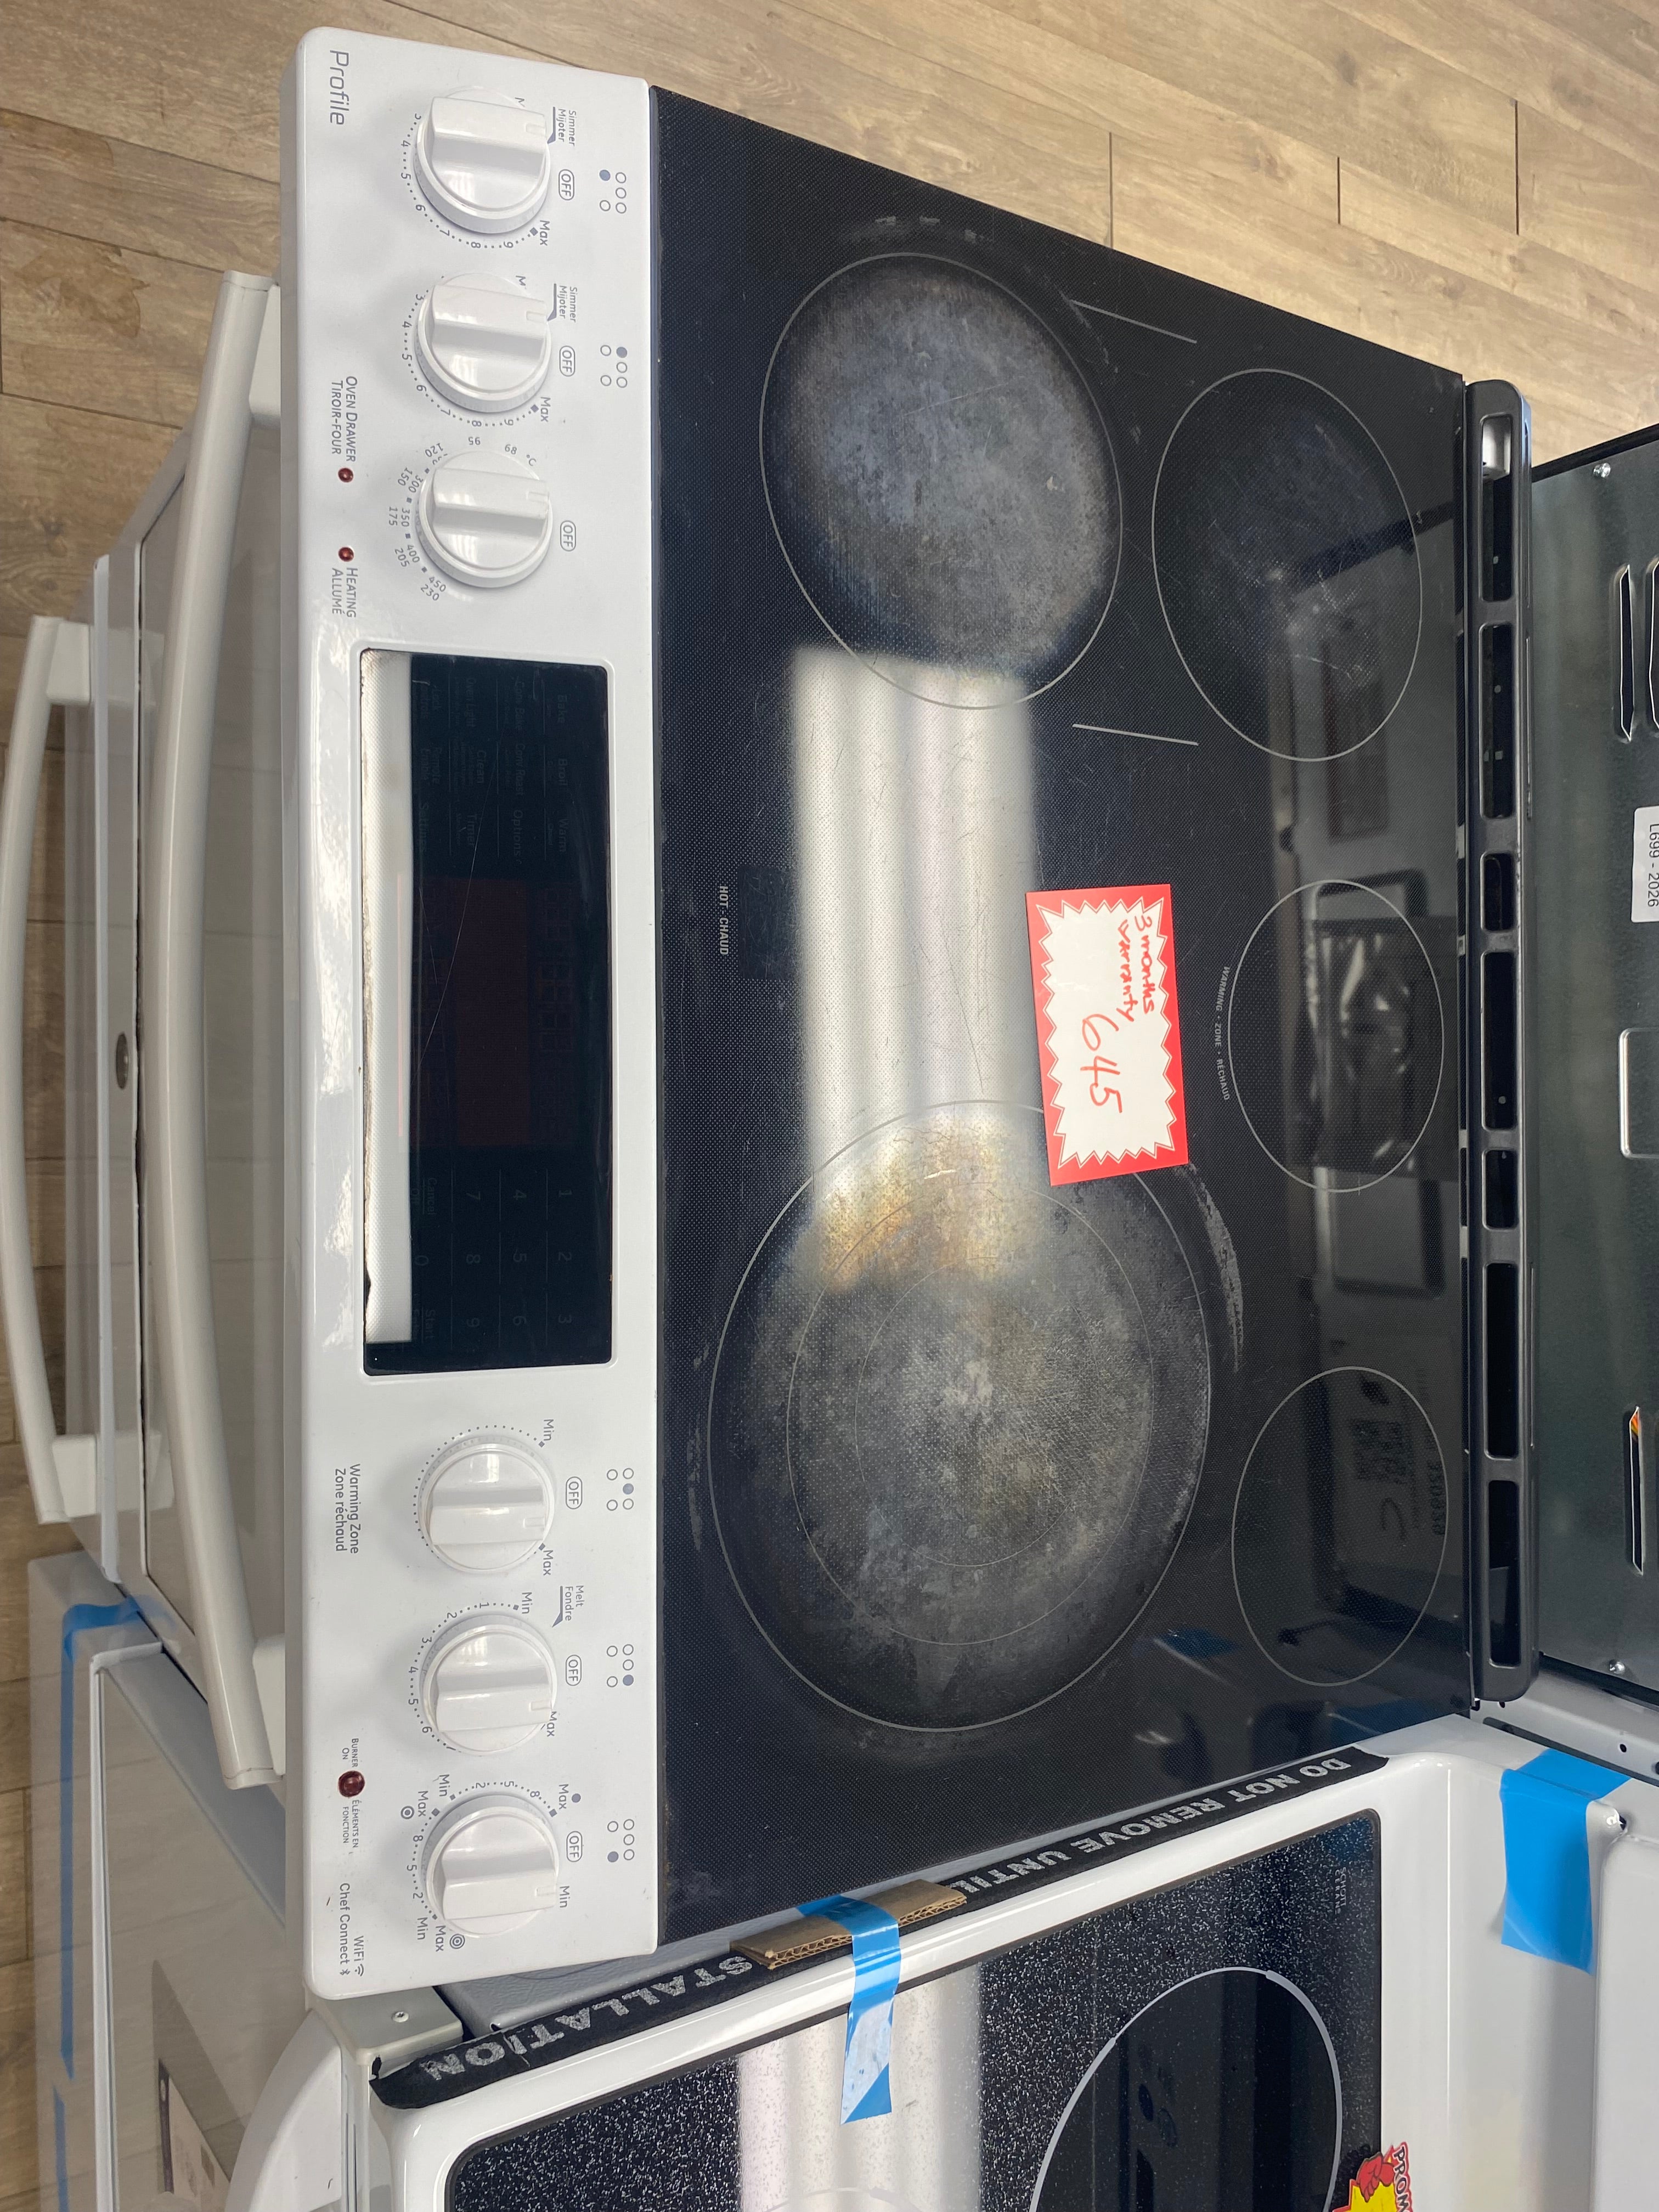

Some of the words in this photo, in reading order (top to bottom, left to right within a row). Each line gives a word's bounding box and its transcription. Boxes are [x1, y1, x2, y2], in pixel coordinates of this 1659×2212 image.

[330, 50, 349, 125] Profile
[556, 109, 566, 142] Mijoter
[561, 174, 571, 196] OFF
[540, 221, 550, 246] Max
[557, 285, 567, 319] Mijoter
[562, 350, 572, 373] OFF
[346, 376, 357, 408] OVEN
[332, 380, 343, 454] TIROIR-FOUR
[540, 397, 550, 422] Max
[346, 413, 357, 461] DRAWER
[425, 443, 443, 457] 120
[398, 467, 413, 486] 150
[409, 475, 423, 493] 300
[389, 506, 398, 526] 175
[401, 508, 410, 527] 350
[563, 525, 573, 548] OFF
[395, 546, 411, 567] 205
[405, 545, 420, 565] 400
[332, 568, 345, 614] ALLUMÉ
[347, 568, 358, 617] HEATING
[421, 583, 439, 601] 230
[429, 575, 448, 594] 450
[464, 703, 476, 727] Light
[557, 695, 567, 724] Bake
[477, 750, 487, 783] Clean
[558, 758, 568, 786] Broil
[516, 769, 525, 796] Roast
[467, 813, 477, 847] Timer
[512, 810, 523, 856] Options
[559, 818, 568, 852] Warm
[719, 885, 729, 907] HOT
[1647, 873, 1659, 907] 2026
[719, 917, 729, 955] CHAUD
[1135, 915, 1153, 932] 3
[1140, 935, 1156, 1014] months
[1216, 967, 1230, 1011] WARMING
[1080, 1013, 1123, 1114] 645
[1216, 1059, 1231, 1101] RÉCHAUD
[427, 1177, 437, 1215] Cancel
[466, 1192, 481, 1200] 7
[512, 1189, 527, 1200] 4
[558, 1189, 572, 1198] 1
[465, 1254, 481, 1265] 8
[513, 1252, 527, 1263] 5
[558, 1251, 572, 1261] 2
[425, 1309, 436, 1340] Start
[465, 1317, 480, 1328] 9
[512, 1315, 526, 1327] 6
[558, 1314, 572, 1324] 3
[544, 1419, 554, 1441] Min
[336, 1469, 346, 1498] Zone
[347, 1464, 361, 1520] Warming
[569, 1482, 579, 1504] OFF
[336, 1502, 347, 1551] réchaud
[351, 1523, 360, 1553] Zone
[543, 1550, 553, 1576] Max
[522, 1592, 532, 1613] Min
[565, 1587, 574, 1621] Fondre
[576, 1585, 584, 1607] Melt
[568, 1660, 578, 1681] OFF
[342, 1748, 349, 1759] ON
[1299, 1758, 1351, 1776] DO
[438, 1774, 450, 1797] Min
[559, 1784, 569, 1809] Max
[1226, 1774, 1300, 1803] NOT
[418, 1791, 428, 1816] Max
[1070, 1797, 1226, 1853] REMOVE
[353, 1838, 358, 1848] EN
[569, 1836, 579, 1857] OFF
[340, 1883, 350, 1910] Chef
[560, 1886, 570, 1908] Min
[340, 1914, 350, 1965] Connect
[417, 1917, 428, 1940] Min
[436, 1926, 446, 1951] Max
[354, 1936, 364, 1961] WiFi
